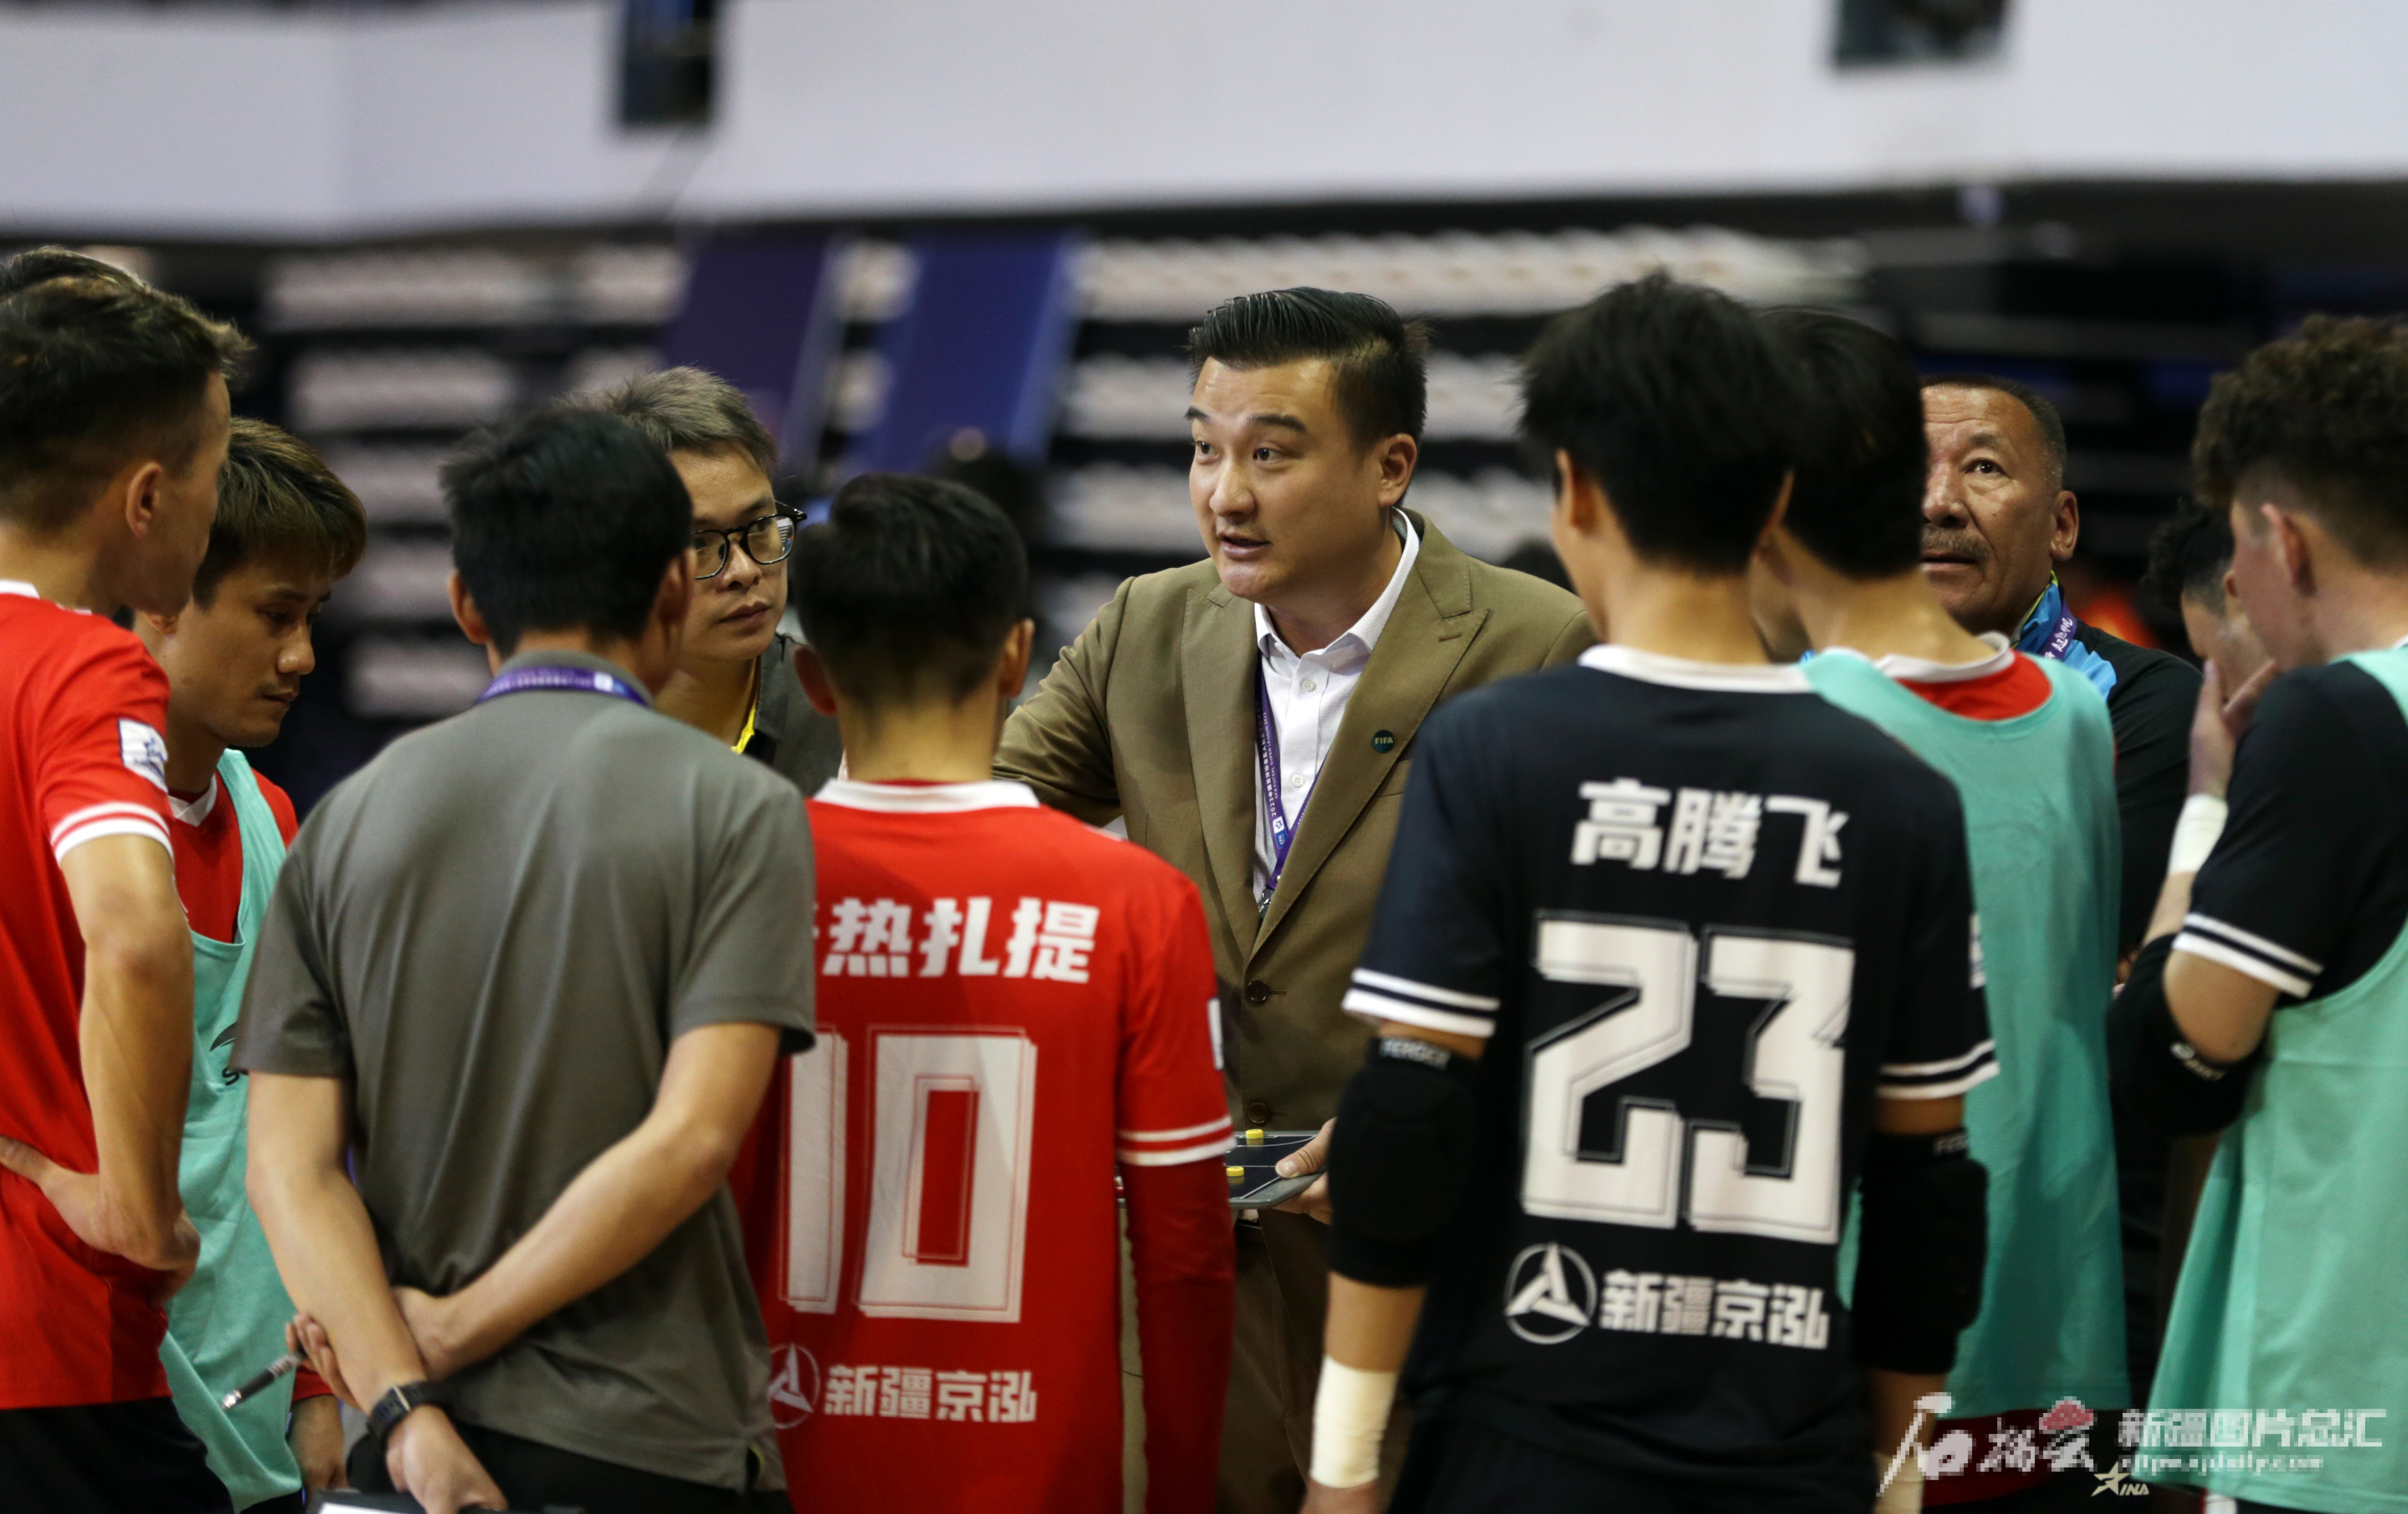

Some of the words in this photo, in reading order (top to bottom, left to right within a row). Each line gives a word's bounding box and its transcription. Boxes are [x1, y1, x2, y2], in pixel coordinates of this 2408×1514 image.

[1569, 776, 1850, 888] 高腾飞
[812, 896, 1100, 984] 热扎提
[1521, 910, 1855, 1244] 23
[778, 1024, 1038, 1324] 10
[1598, 1268, 1832, 1351] 新疆京泓
[824, 1364, 1038, 1423] 新疆京泓
